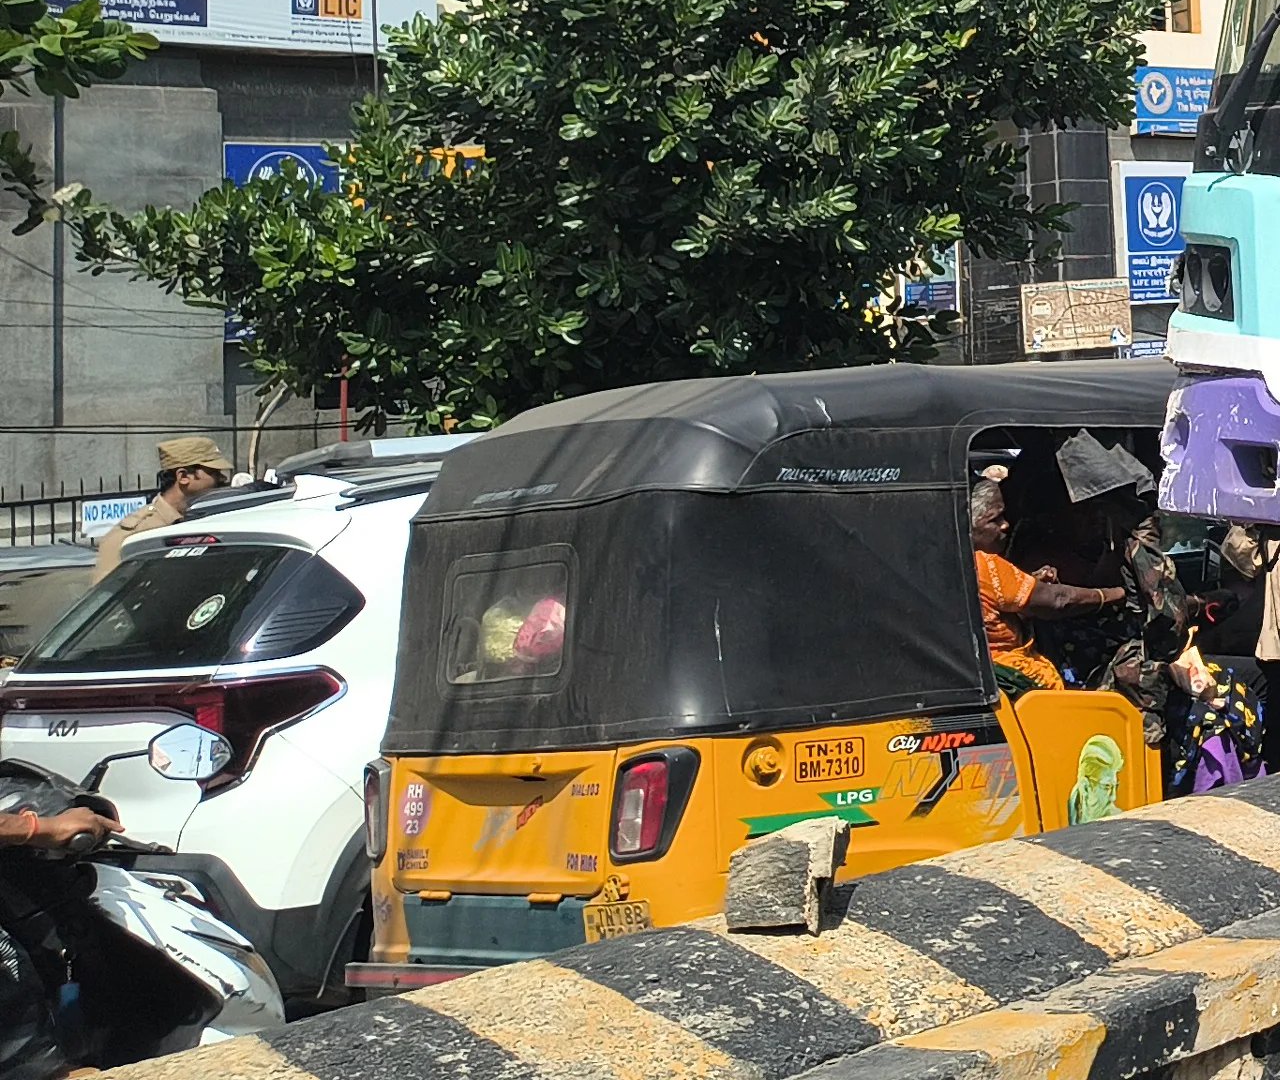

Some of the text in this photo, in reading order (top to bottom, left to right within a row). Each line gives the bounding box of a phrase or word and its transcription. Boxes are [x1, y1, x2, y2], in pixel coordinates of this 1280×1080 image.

[84, 505, 99, 521] NO
[48, 719, 79, 737] KIA
[805, 741, 854, 758] TN-18
[888, 735, 921, 753] City
[799, 755, 860, 780] BM-7310
[407, 784, 424, 799] RH
[836, 789, 874, 806] LPG
[403, 801, 424, 817] 499
[405, 819, 419, 835] 23
